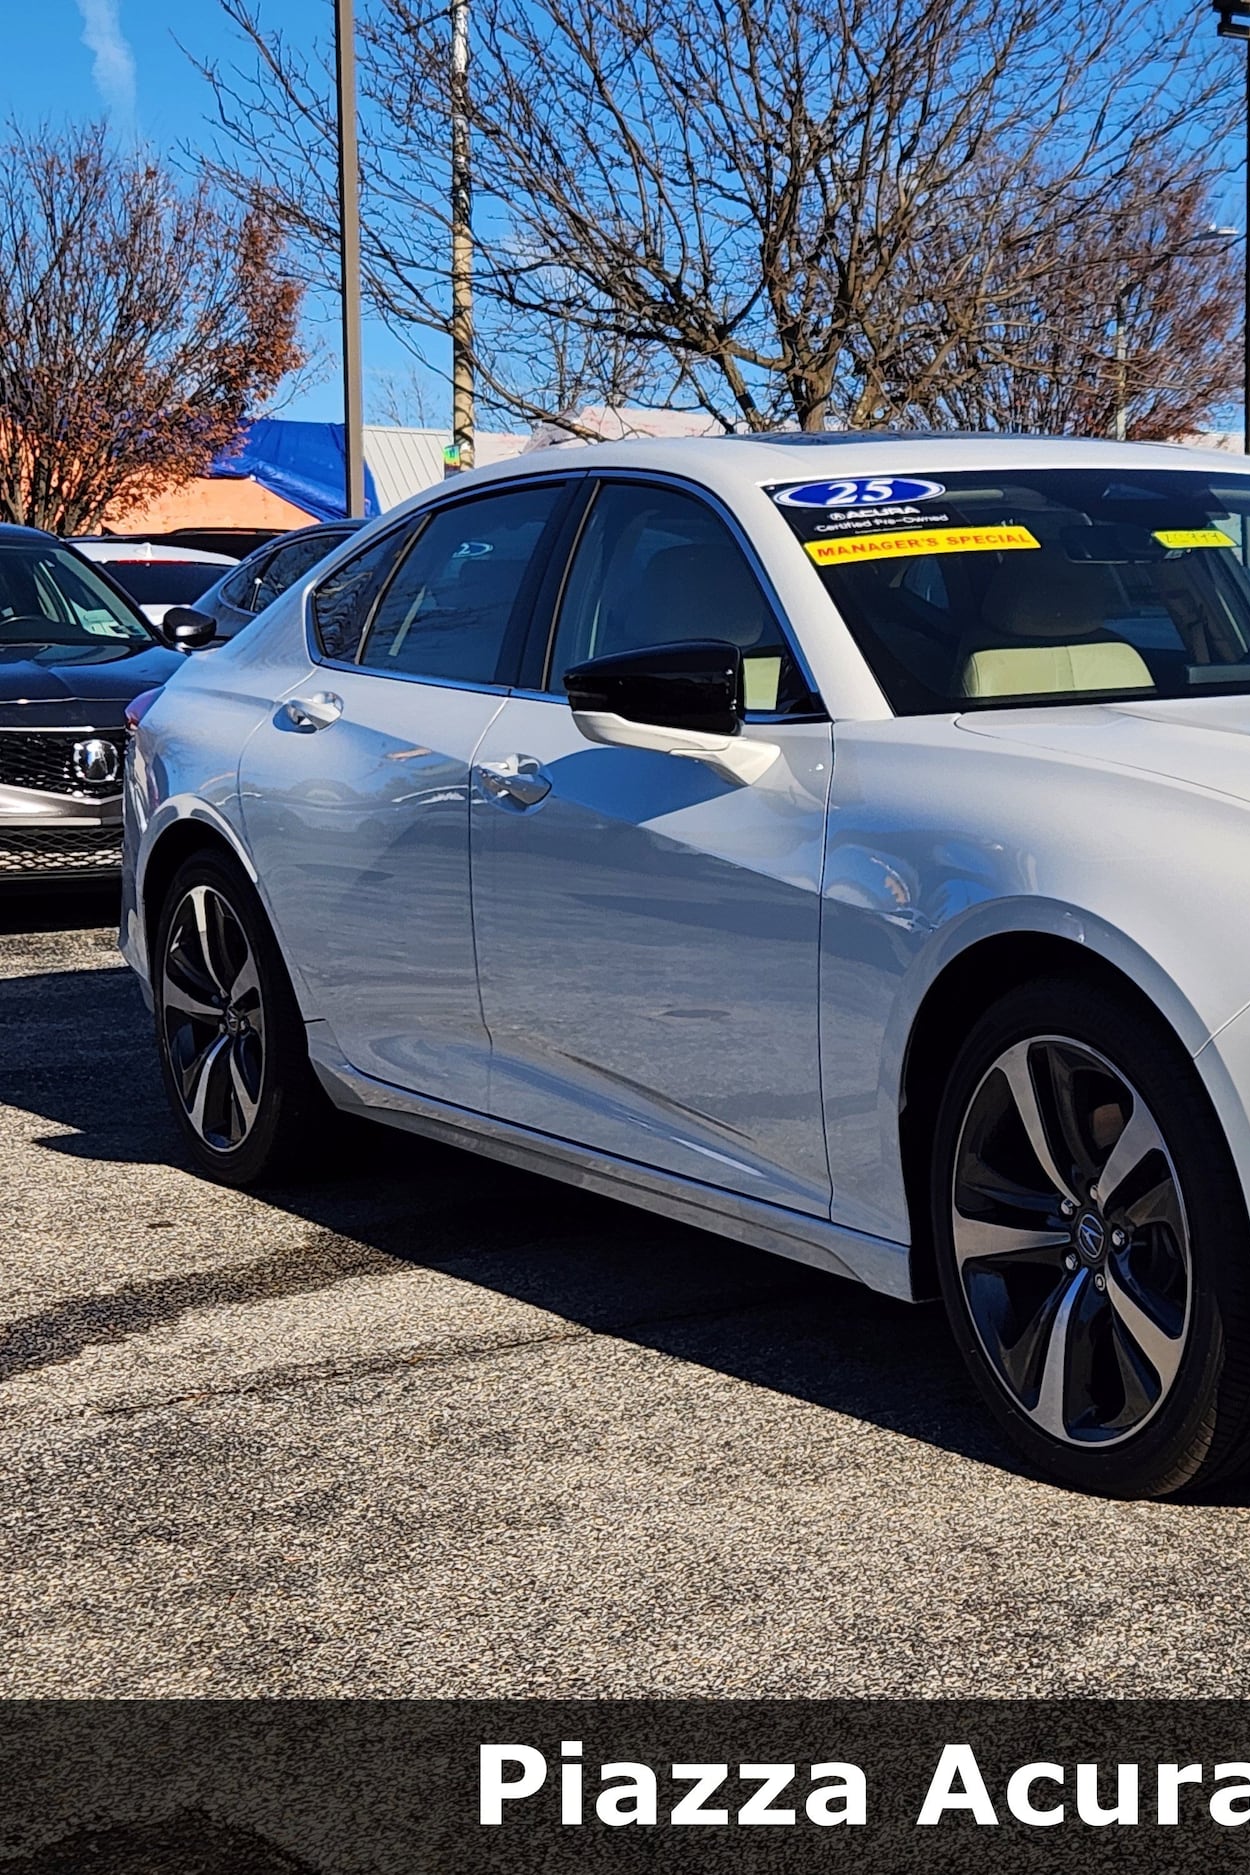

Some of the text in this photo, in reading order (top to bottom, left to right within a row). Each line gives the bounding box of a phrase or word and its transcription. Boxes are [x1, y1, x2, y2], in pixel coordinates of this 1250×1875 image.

[826, 479, 895, 505] 25
[815, 520, 872, 533] Certified
[874, 514, 949, 527] Pre-Owned
[846, 506, 921, 519] ACURA
[817, 533, 1031, 558] MANAGER'S SPECIAL
